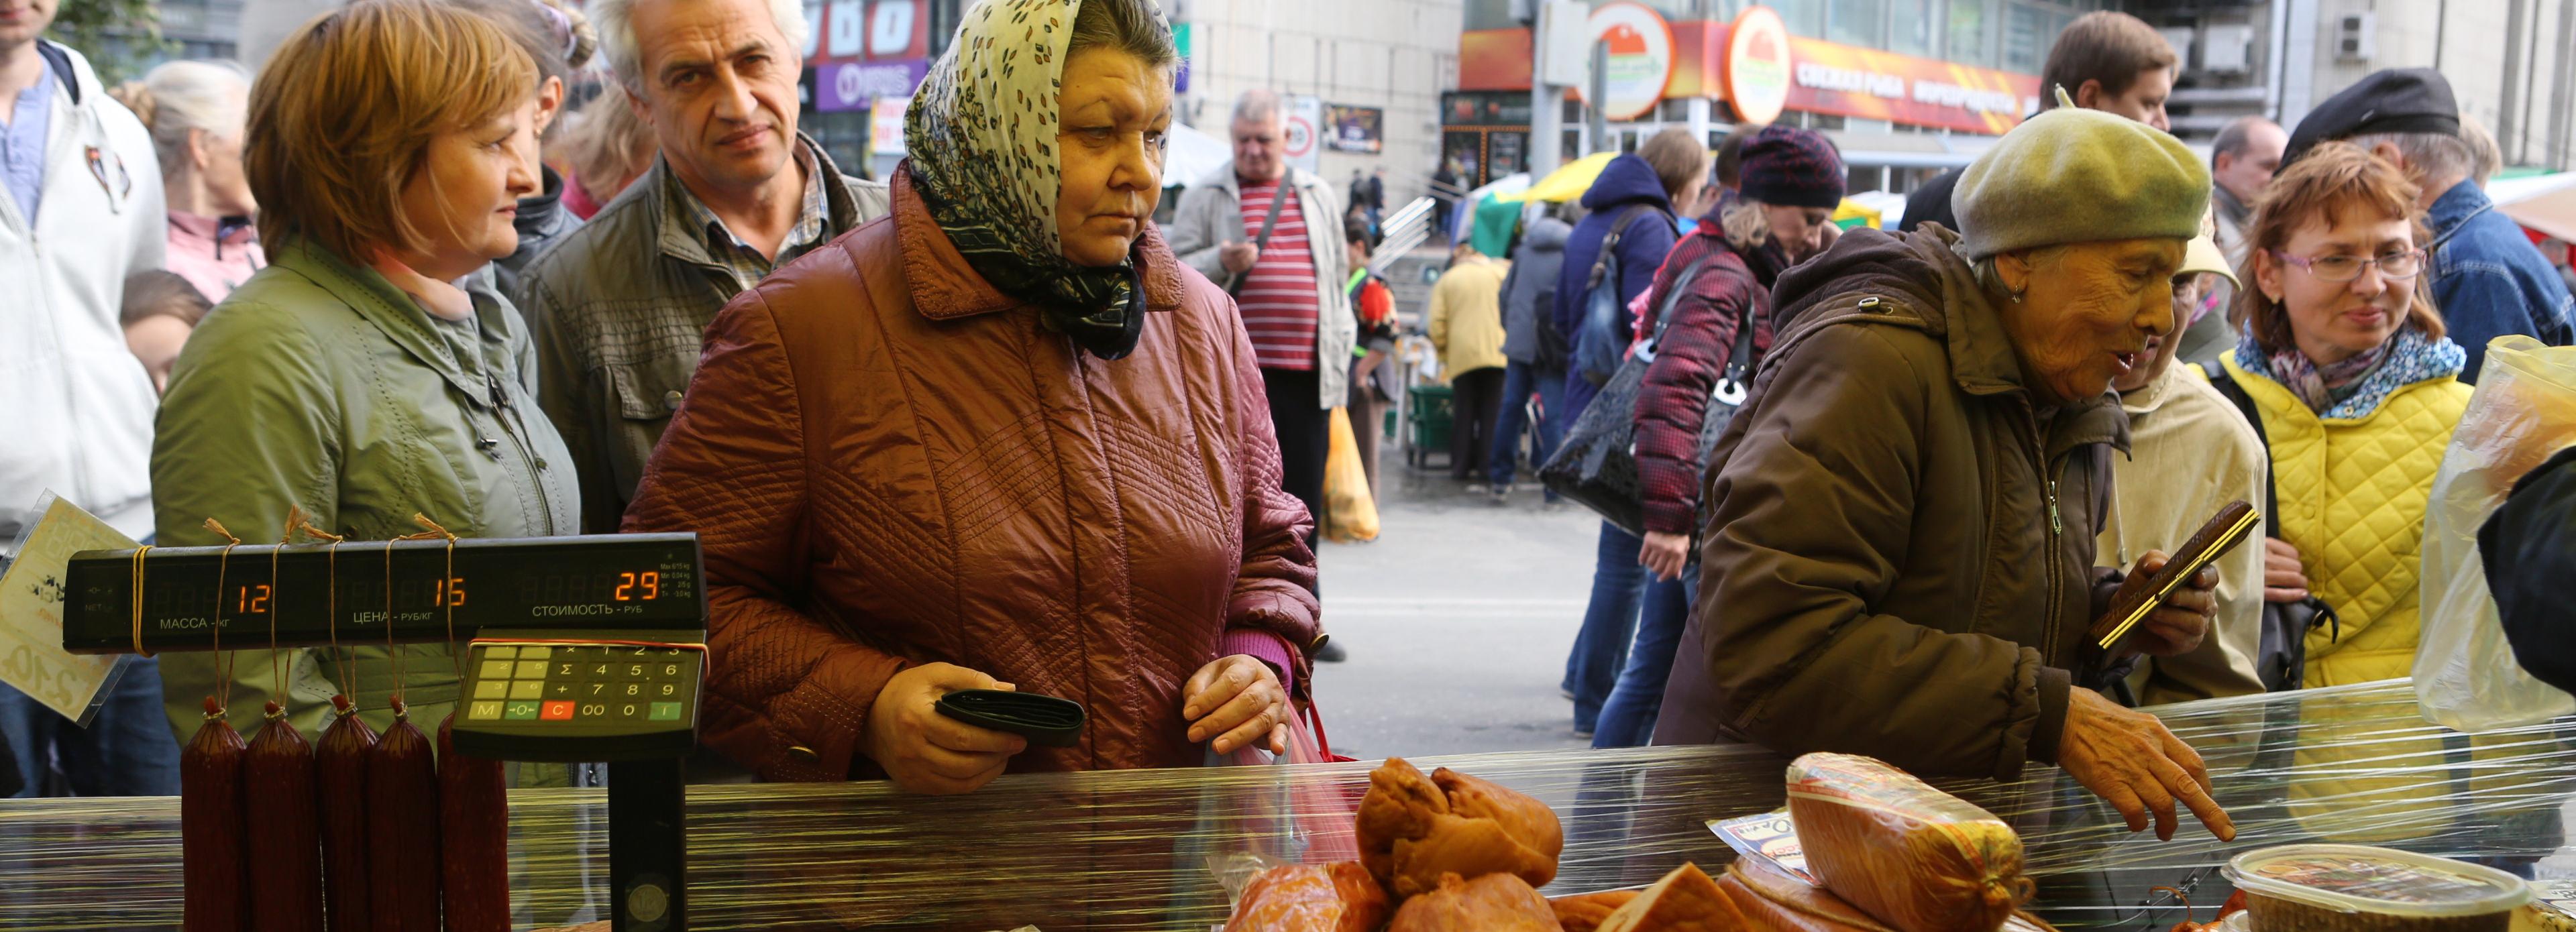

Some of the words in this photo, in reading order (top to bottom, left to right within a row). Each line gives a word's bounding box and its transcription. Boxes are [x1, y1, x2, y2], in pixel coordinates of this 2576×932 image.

[435, 577, 465, 606] 15
[615, 572, 658, 601] 29
[238, 585, 270, 614] 12
[532, 604, 613, 616] СТОИМОСТЬ
[624, 605, 643, 614] РУБ
[160, 618, 208, 630] МАССА
[354, 611, 389, 625] ЦЕНА
[634, 647, 645, 656] 2
[596, 664, 606, 675] 4
[631, 664, 642, 675] 5
[665, 664, 677, 675] 6
[593, 685, 604, 695] 7
[627, 685, 639, 695] 8
[662, 685, 674, 695] 9
[477, 705, 494, 715] M
[552, 705, 564, 715] C
[582, 705, 604, 715] 00
[623, 705, 635, 715] 0
